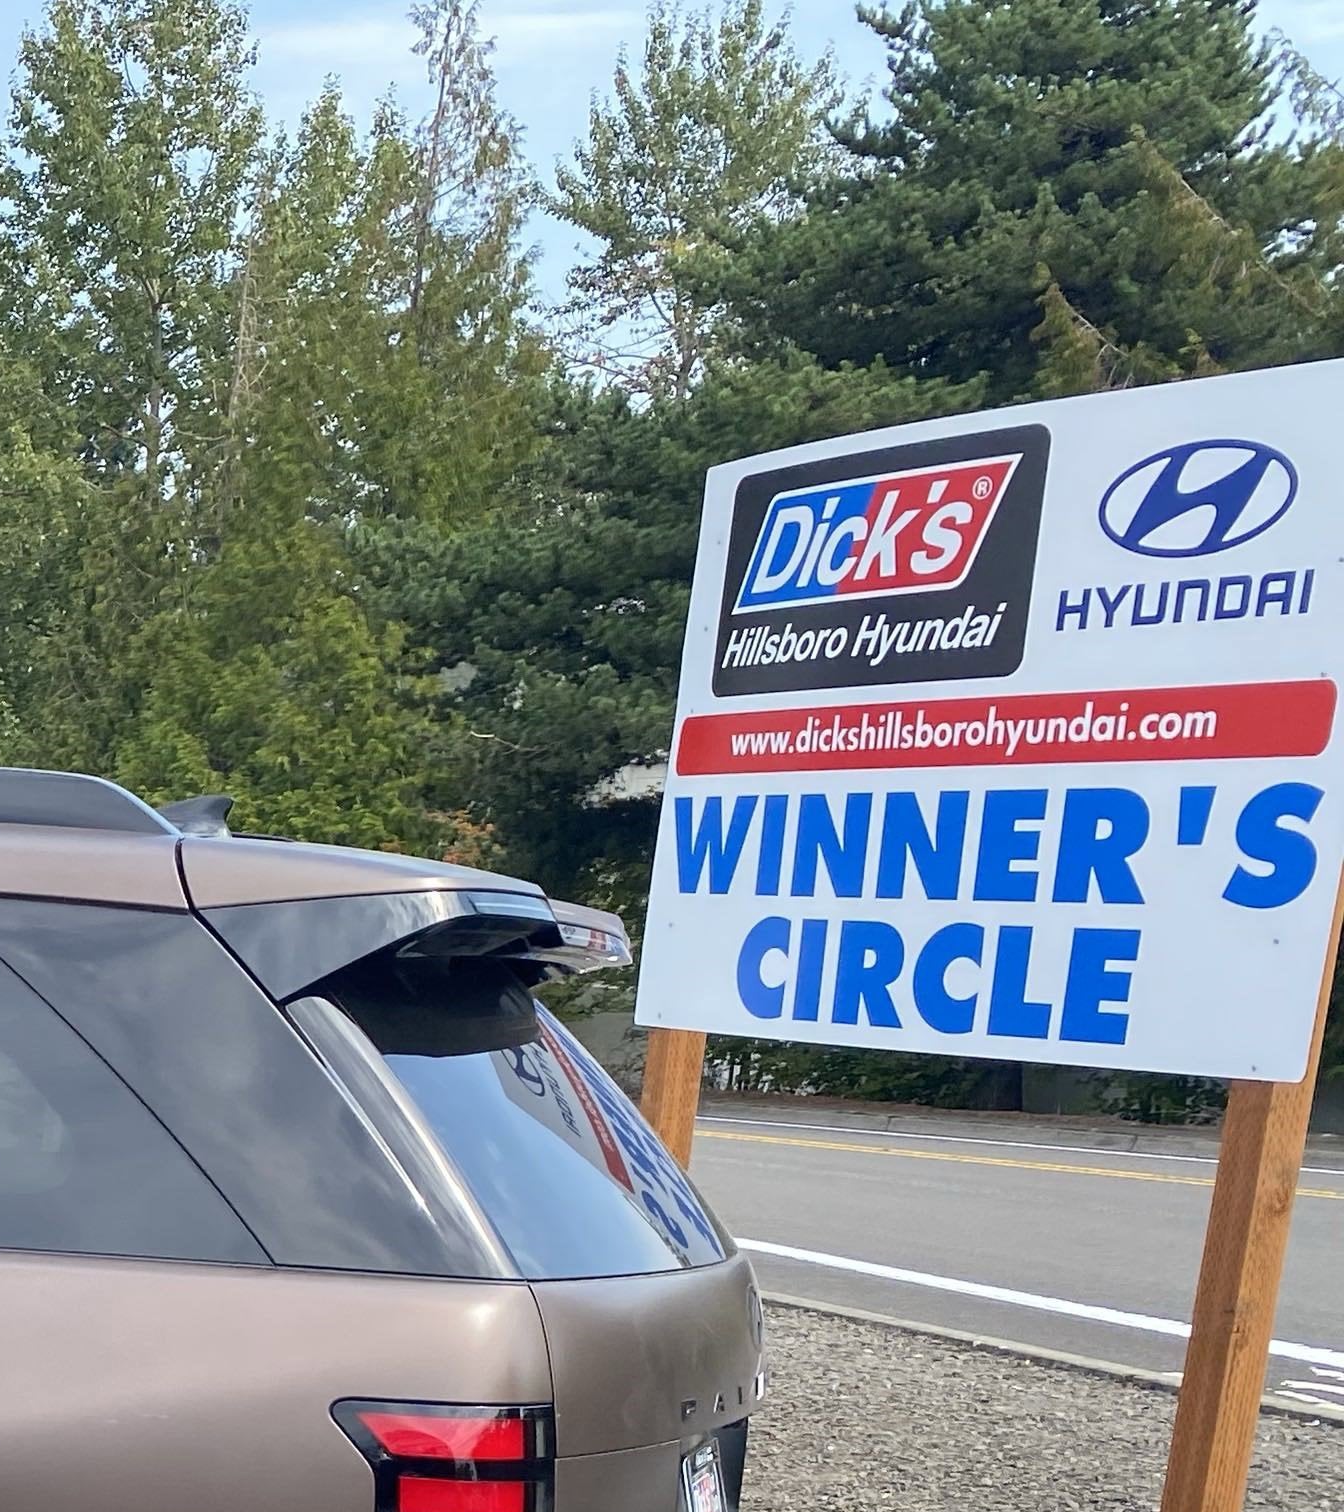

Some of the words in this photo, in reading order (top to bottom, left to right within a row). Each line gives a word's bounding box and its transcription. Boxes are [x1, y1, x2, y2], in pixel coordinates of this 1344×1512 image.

[1055, 569, 1314, 632] HYUNDAI
[721, 622, 848, 669] Hillsboro
[851, 602, 1008, 667] Hyundai
[730, 702, 1216, 756] www.dickshillsborohyundai.com
[674, 782, 1326, 909] WINNER'S
[736, 916, 1142, 1045] CIRCLE
